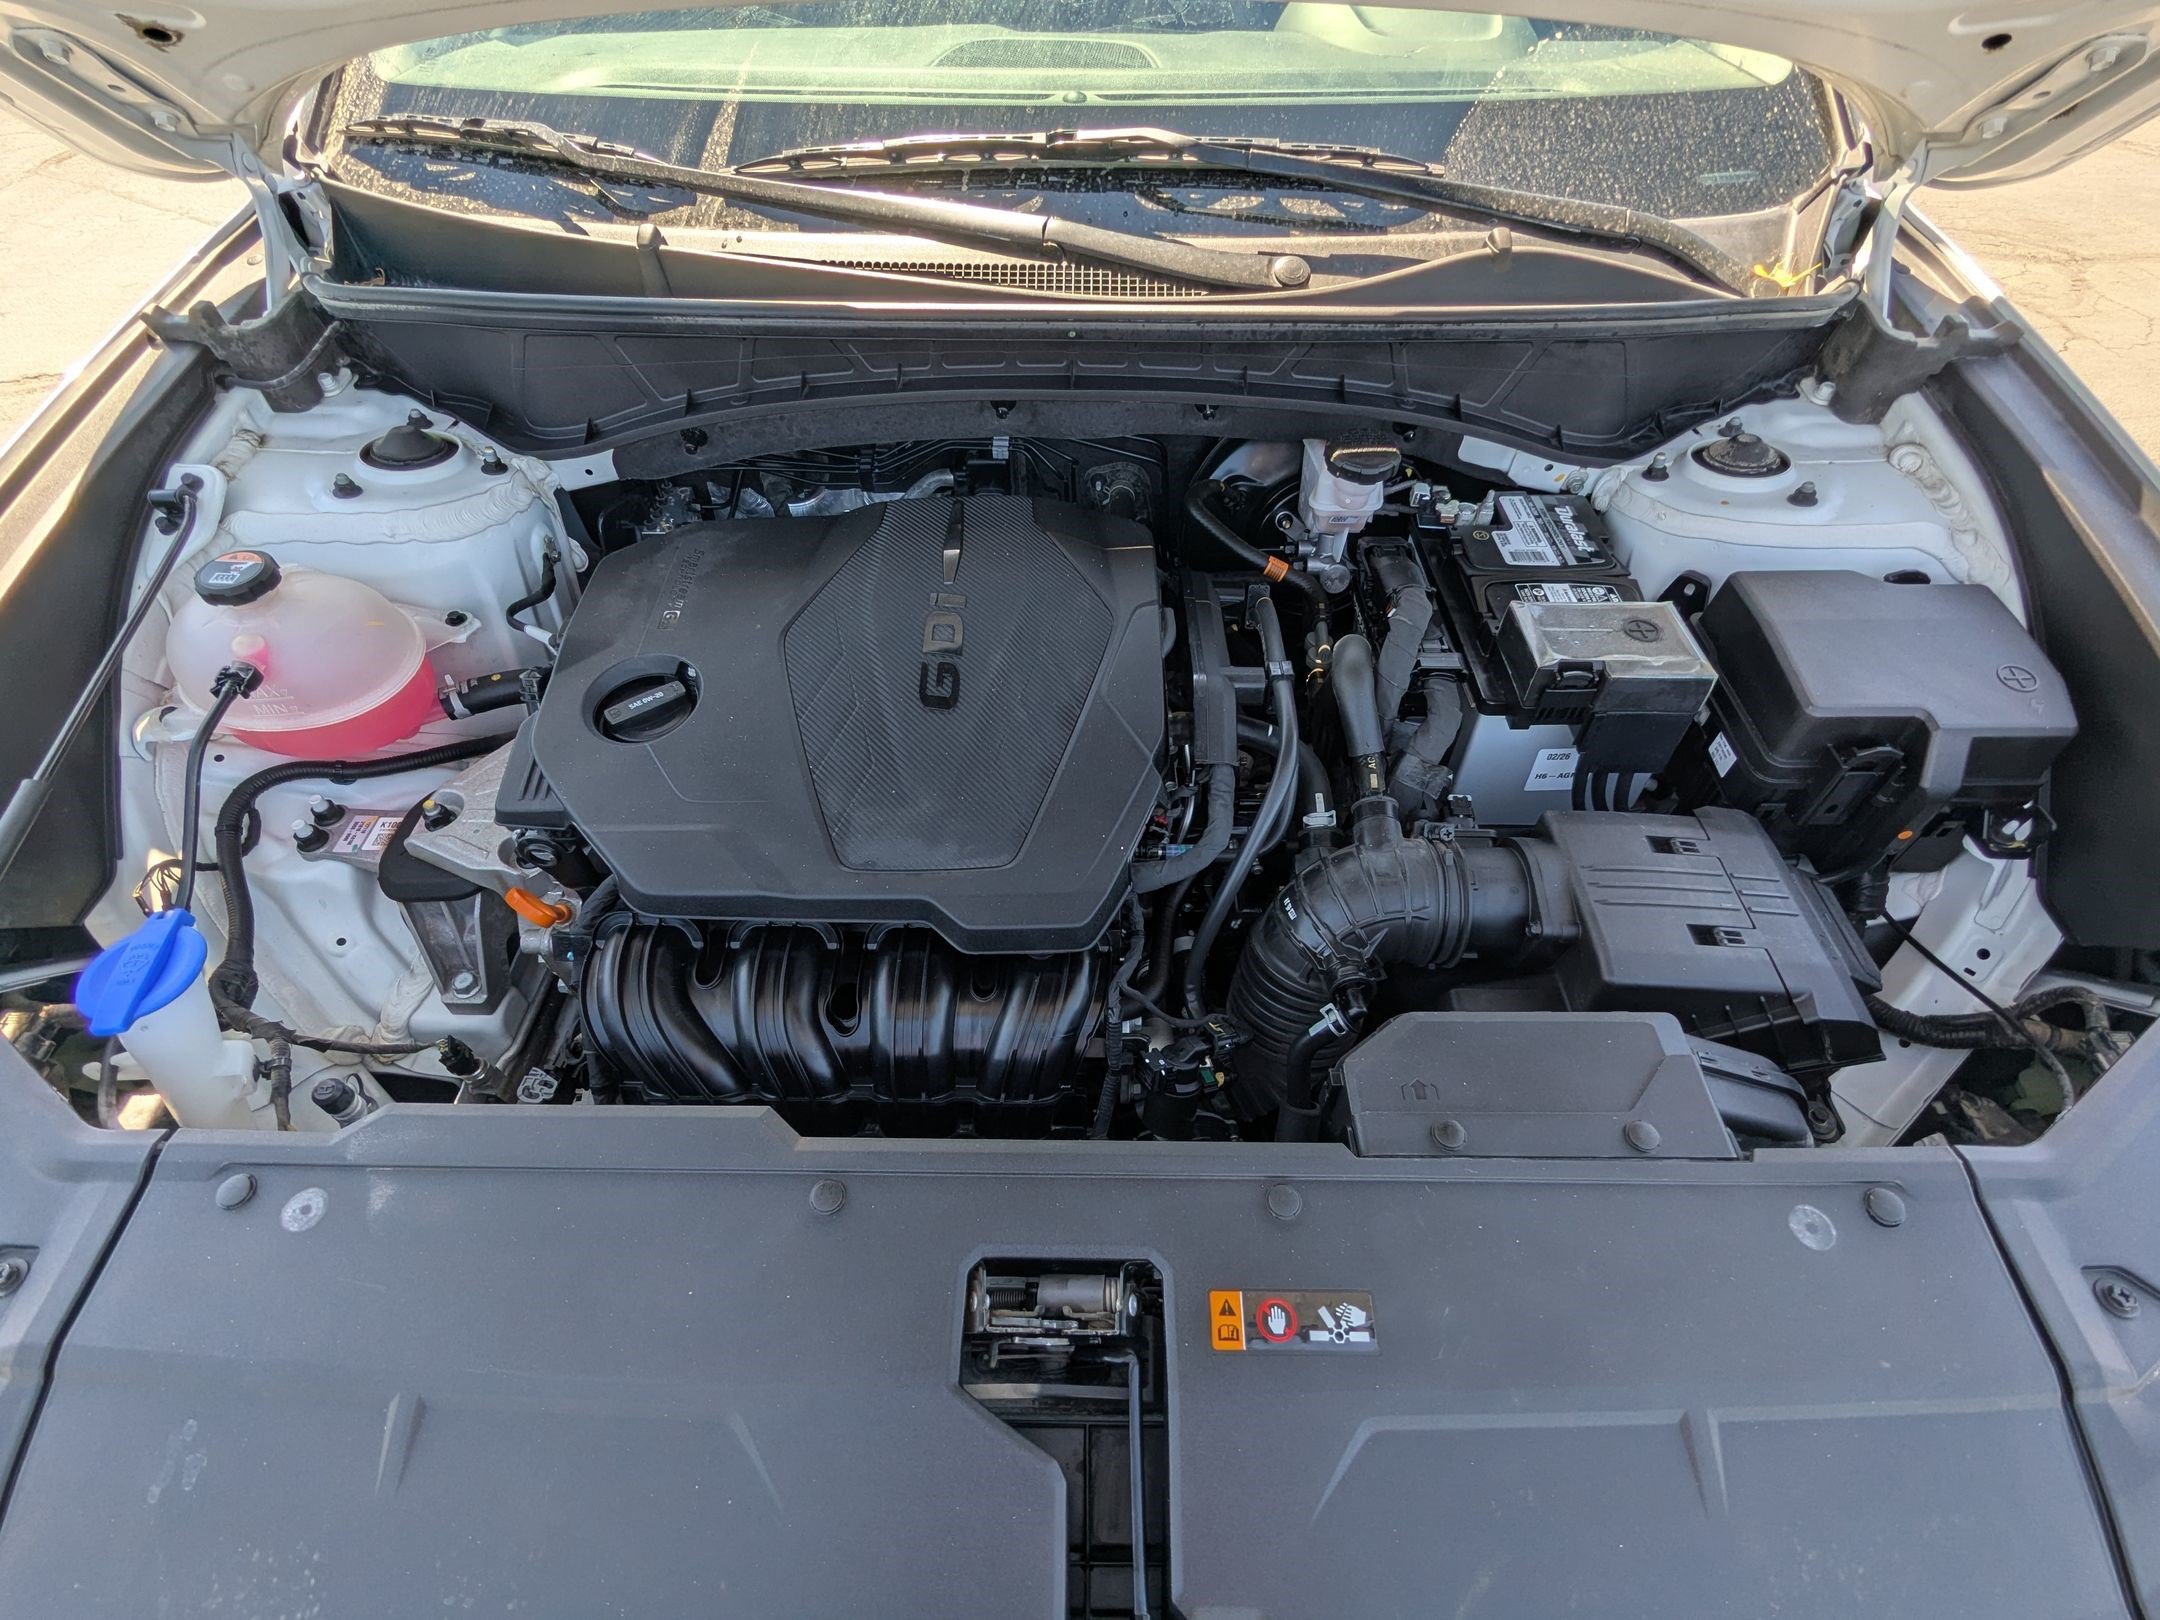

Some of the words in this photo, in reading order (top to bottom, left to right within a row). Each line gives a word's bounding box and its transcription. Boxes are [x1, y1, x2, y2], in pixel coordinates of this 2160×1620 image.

[1554, 505, 1595, 553] Duralast
[674, 547, 705, 609] Smartstream
[253, 703, 288, 715] MIN
[628, 700, 643, 710] SAE
